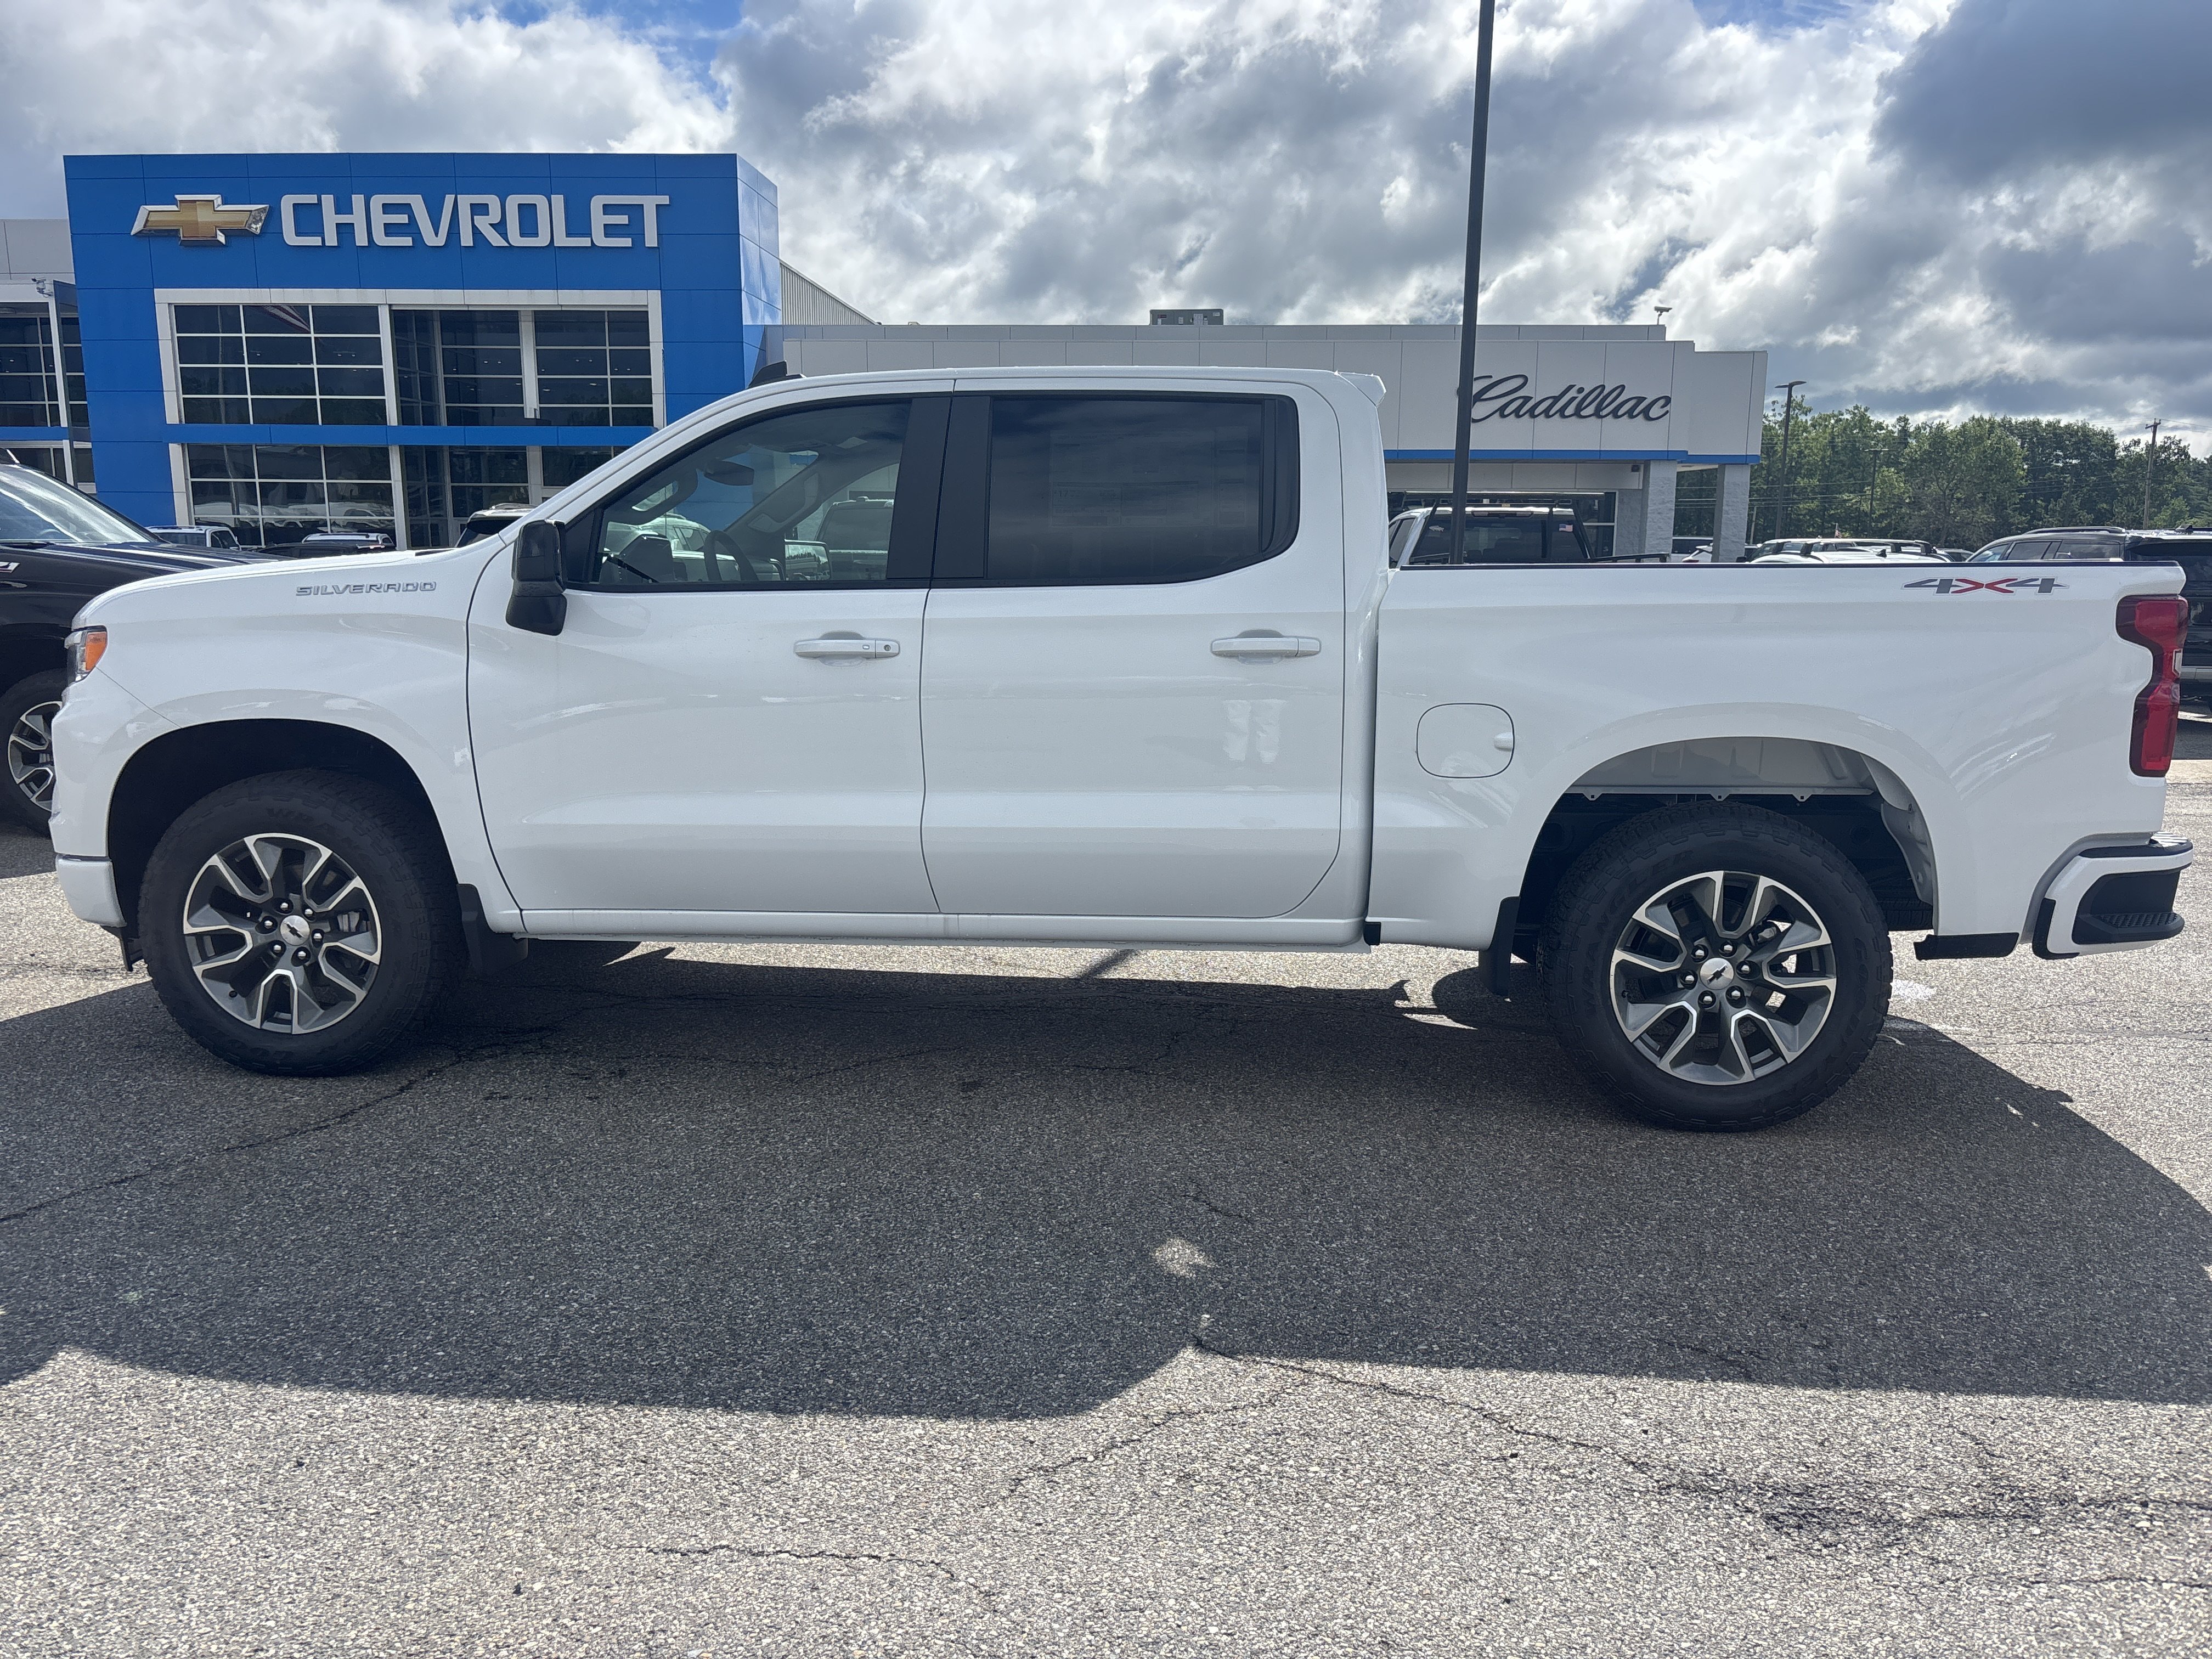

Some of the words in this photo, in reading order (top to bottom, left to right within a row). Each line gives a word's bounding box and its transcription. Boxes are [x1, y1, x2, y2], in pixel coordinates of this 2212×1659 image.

[280, 194, 670, 248] CHEVROLET
[1457, 374, 1672, 424] Cadillac
[296, 580, 437, 596] SILVERADO
[1579, 845, 1695, 1018] WRANGLER
